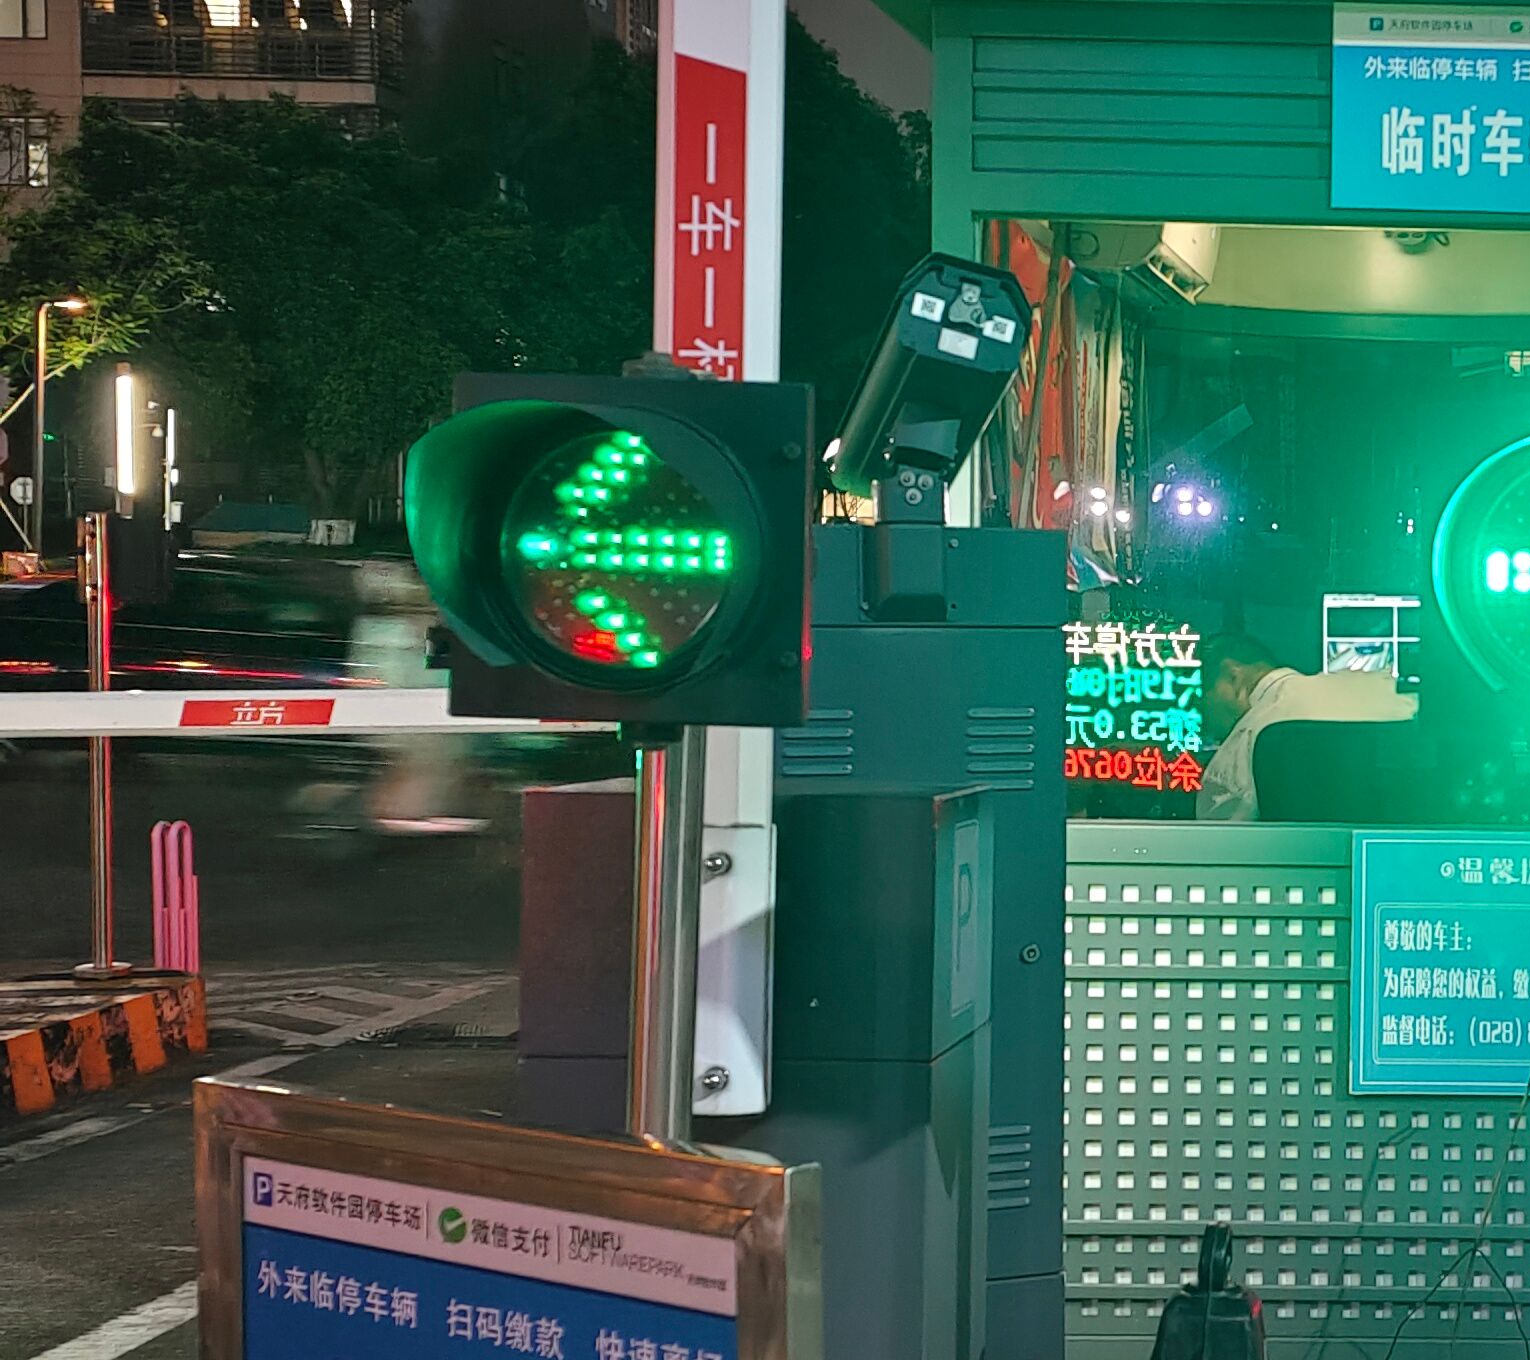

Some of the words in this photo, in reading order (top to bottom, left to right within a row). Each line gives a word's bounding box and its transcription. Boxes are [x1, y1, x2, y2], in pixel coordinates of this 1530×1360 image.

[1364, 55, 1498, 81] 外来临停车辆
[1384, 920, 1473, 952] 尊敬的车主：
[277, 1182, 421, 1230] 天府软件园停车场
[471, 1217, 550, 1258] 微信支付
[257, 1260, 418, 1329] 外来临停车辆
[446, 1298, 564, 1360] 扫码缴款
